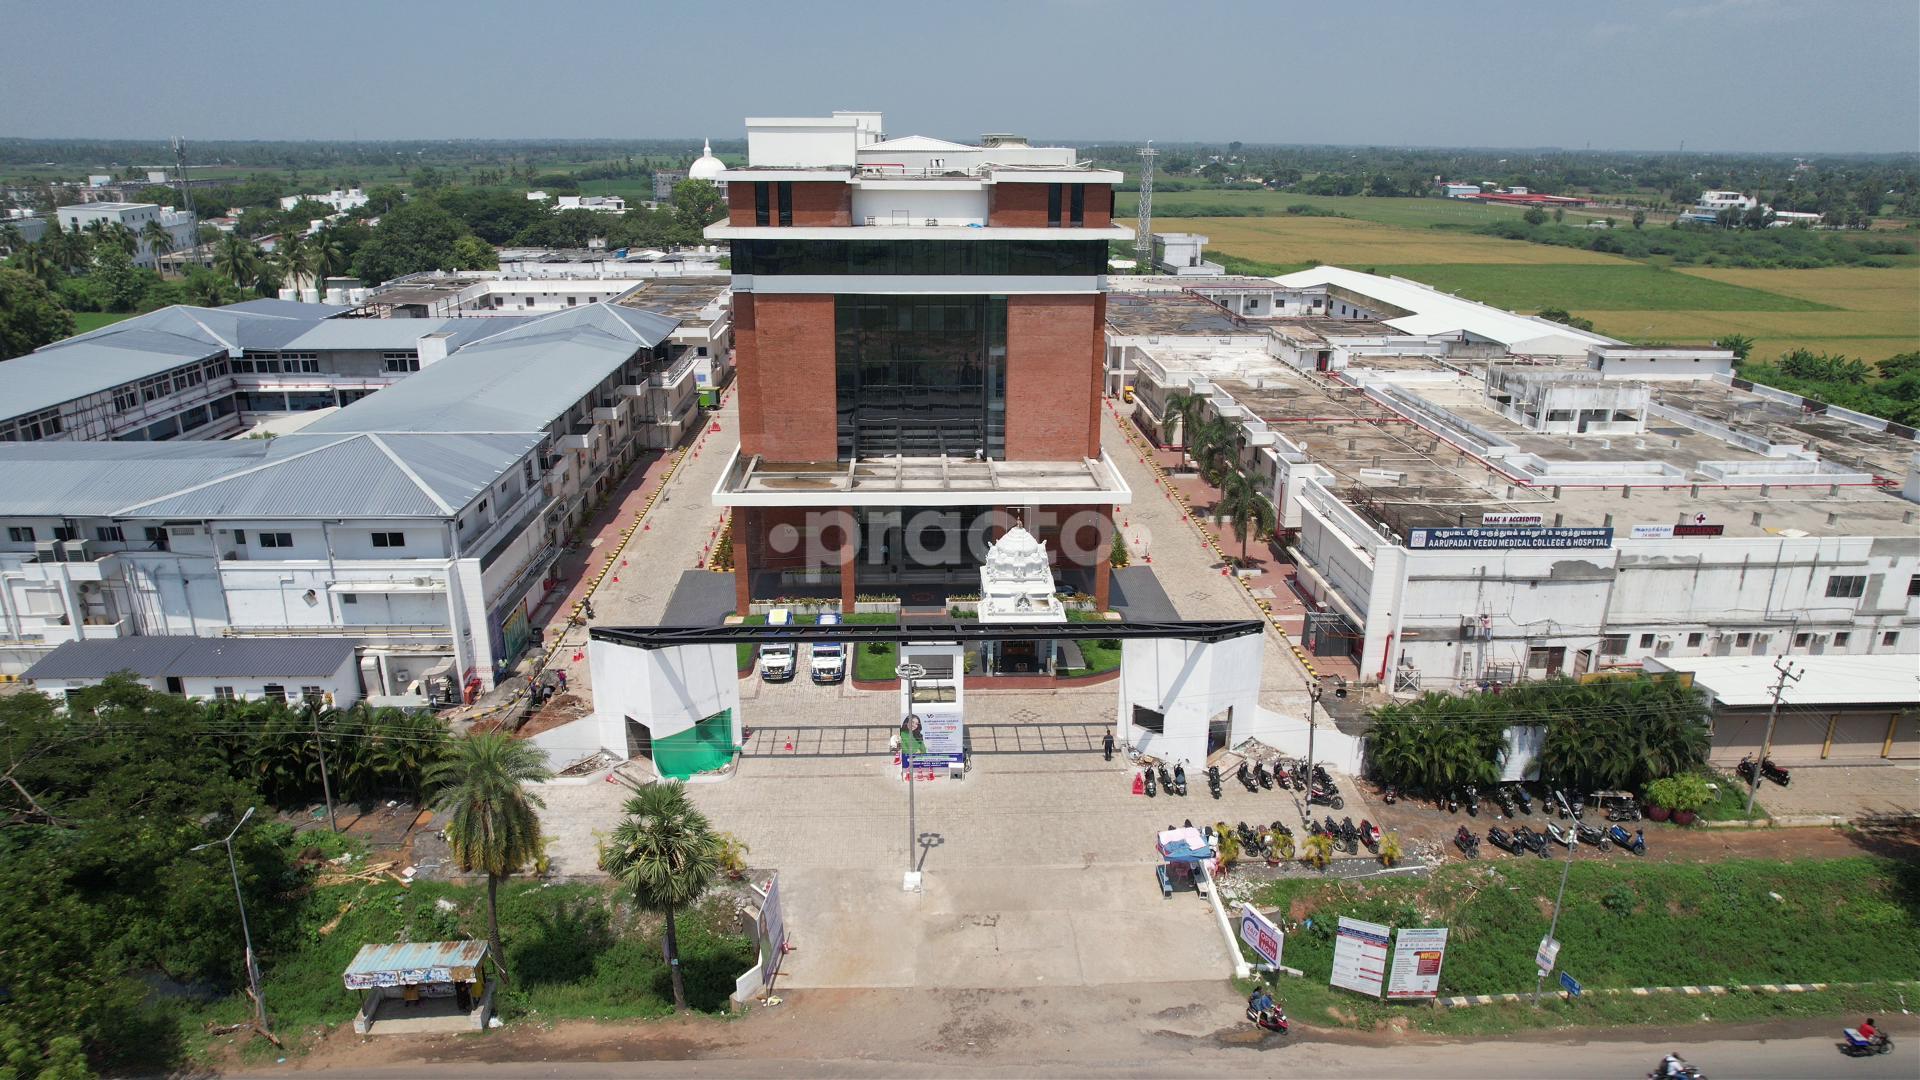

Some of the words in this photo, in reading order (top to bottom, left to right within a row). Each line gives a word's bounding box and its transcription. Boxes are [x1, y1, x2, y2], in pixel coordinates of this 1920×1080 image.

[1428, 539, 1471, 547] AARUPADAI
[1473, 539, 1498, 547] VEEDU
[1499, 538, 1531, 547] MEDICAL
[1532, 538, 1566, 547] COLLEGE
[1566, 539, 1572, 547] &
[1572, 538, 1609, 547] HOSPITAL
[1261, 931, 1277, 947] OPEN
[1260, 940, 1276, 959] NOW
